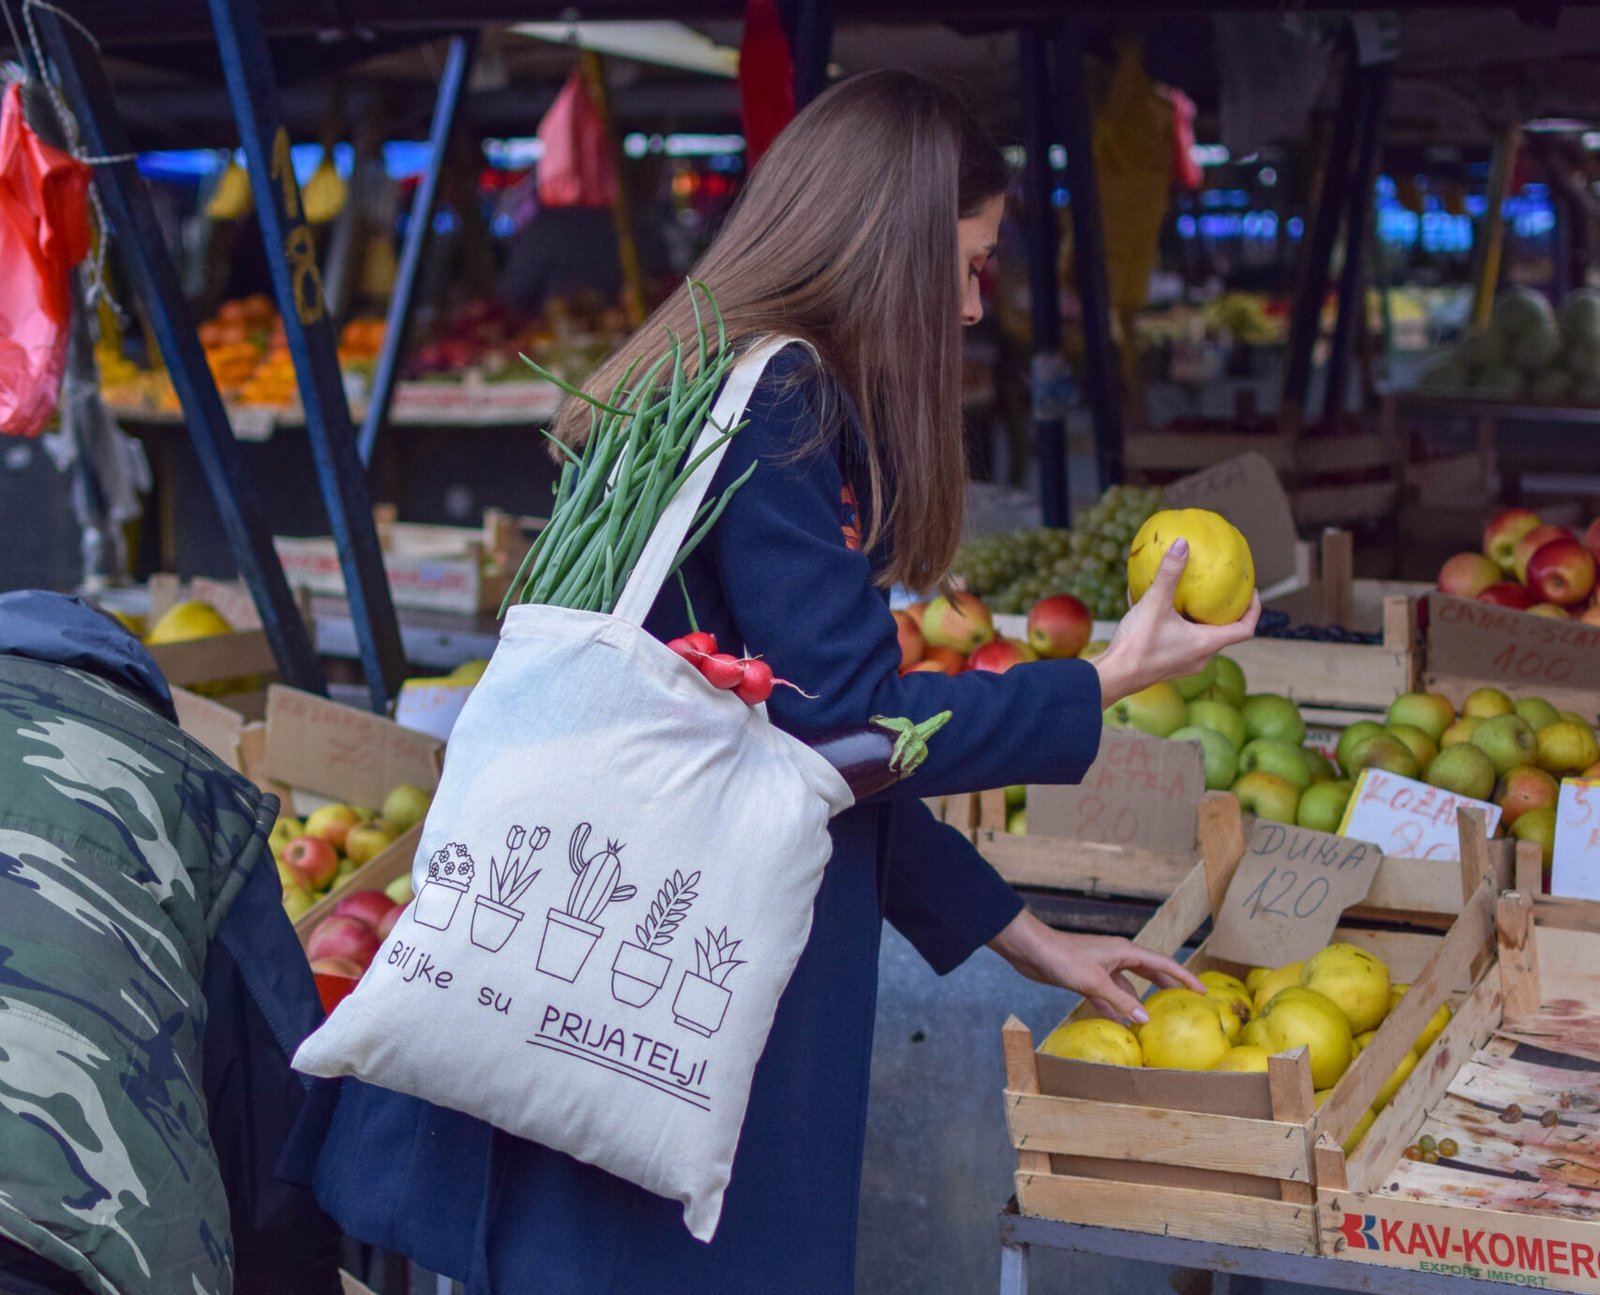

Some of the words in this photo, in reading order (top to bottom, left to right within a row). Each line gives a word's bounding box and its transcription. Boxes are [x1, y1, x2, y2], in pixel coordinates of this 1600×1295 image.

[1493, 643, 1575, 681] 100
[1107, 738, 1150, 768] CA
[1094, 766, 1186, 799] ATKA
[1242, 866, 1330, 919] 120
[387, 940, 453, 988] Biljke
[477, 986, 512, 1014] su
[540, 1004, 708, 1085] PRIJATELJI
[1380, 1218, 1600, 1279] KAV-KOMER
[1419, 1260, 1483, 1278] EXPORT
[1487, 1269, 1548, 1286] IMPORT
